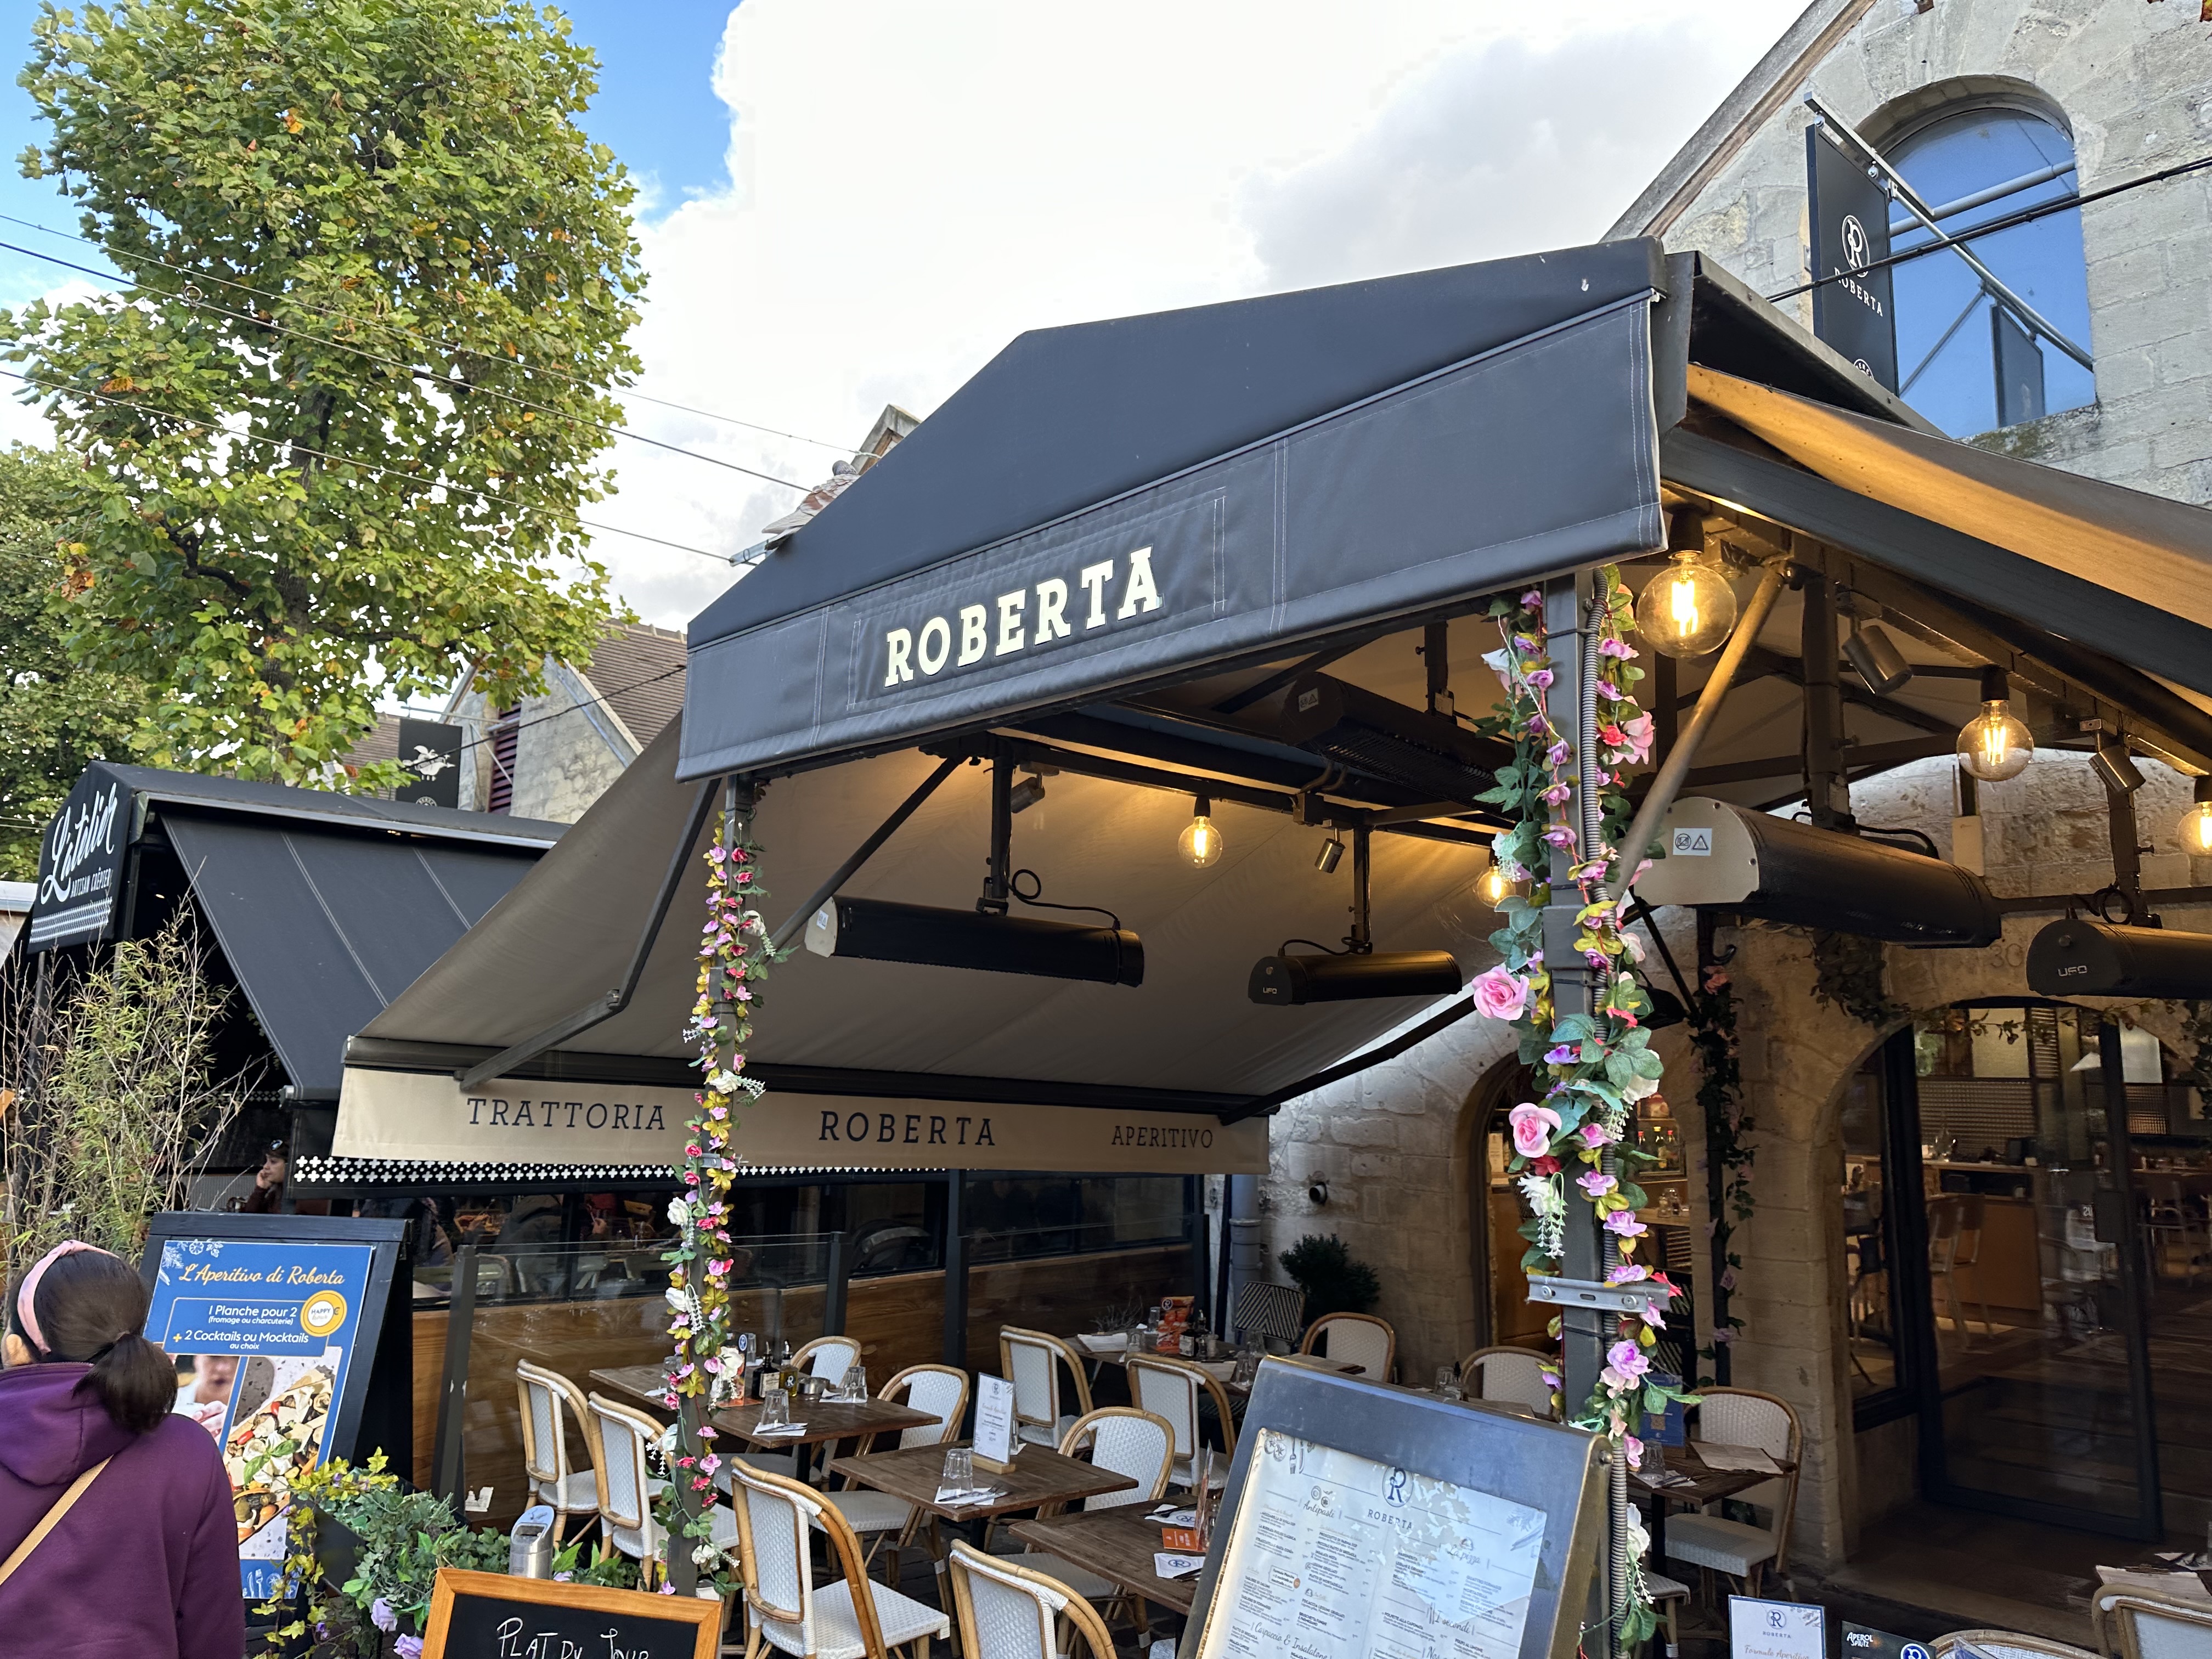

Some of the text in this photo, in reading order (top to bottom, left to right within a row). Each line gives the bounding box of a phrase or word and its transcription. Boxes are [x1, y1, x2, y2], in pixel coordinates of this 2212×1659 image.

[885, 545, 1163, 687] ROBERTA
[2057, 964, 2088, 977] UFO
[1262, 986, 1277, 995] UFO
[467, 1098, 1214, 1149] TRATTORIA ROBERTA APERITIVO
[266, 1266, 285, 1283] di
[286, 1266, 346, 1285] Roberta
[215, 1305, 259, 1317] Planche
[262, 1308, 288, 1318] pour
[290, 1307, 297, 1317] 2
[208, 1316, 240, 1325] (fromage
[184, 1330, 193, 1340] 2
[194, 1330, 241, 1342] Cocktails
[242, 1334, 256, 1342] ou
[259, 1332, 309, 1344] Mocktails
[1303, 1500, 1335, 1518] Antipasti
[1368, 1509, 1413, 1530] ROBERTA
[1255, 1622, 1282, 1641] Carpaccio
[1442, 1619, 1470, 1634] secondi
[1762, 1631, 1792, 1639] ROBERTA
[1847, 1632, 1874, 1642] APEROL
